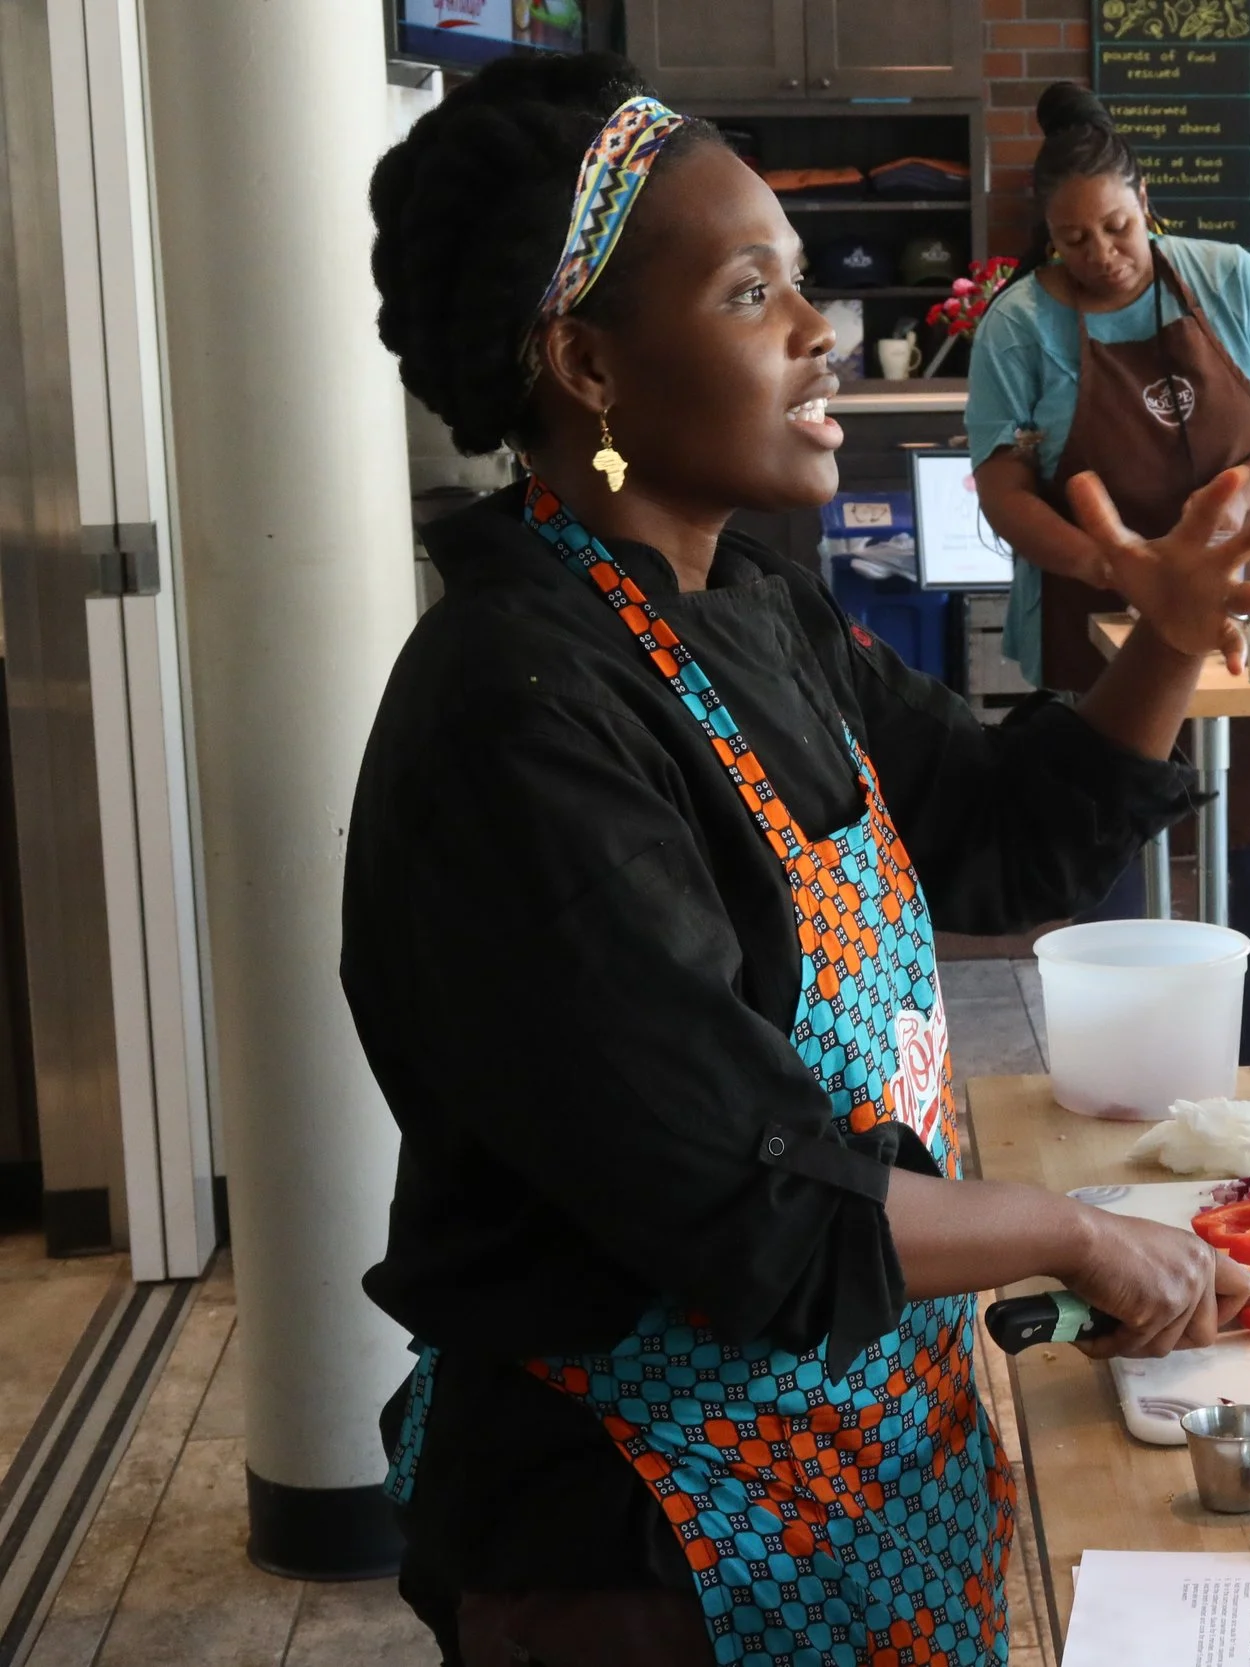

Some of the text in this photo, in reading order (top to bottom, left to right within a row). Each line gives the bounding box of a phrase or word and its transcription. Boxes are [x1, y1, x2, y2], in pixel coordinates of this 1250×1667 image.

[1102, 49, 1216, 64] pounds of food
[1127, 67, 1181, 80] rescued
[1110, 104, 1187, 117] transformed
[1114, 122, 1222, 140] servings shared
[1171, 157, 1184, 168] of
[1194, 156, 1223, 168] food
[1145, 171, 1220, 184] distributed
[1197, 216, 1236, 231] hours
